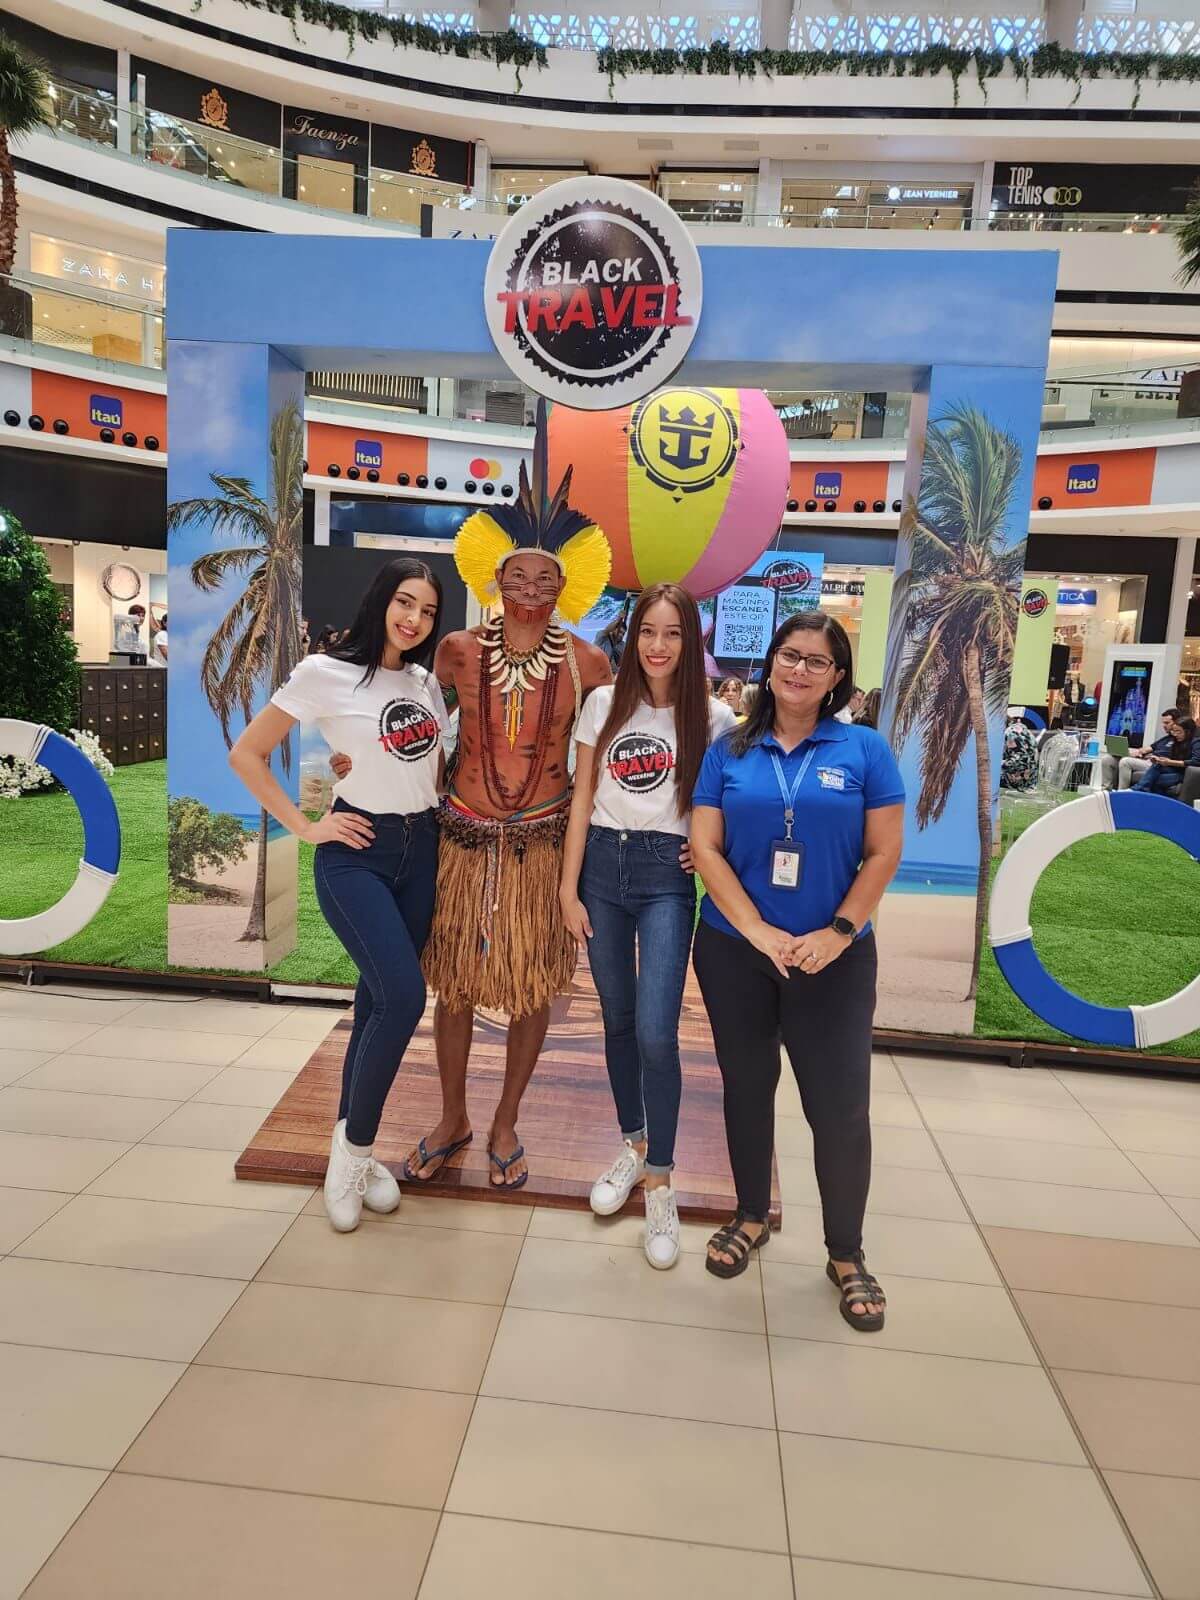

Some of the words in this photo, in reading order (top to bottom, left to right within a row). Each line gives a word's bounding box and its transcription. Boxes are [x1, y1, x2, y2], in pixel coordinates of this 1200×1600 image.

[291, 115, 360, 150] Faenza
[1010, 166, 1033, 186] TOP
[902, 190, 923, 199] JEAN
[924, 190, 959, 199] VERNIER
[1008, 185, 1042, 206] TENIS
[542, 257, 643, 286] BLACK
[497, 281, 693, 334] TRAVEL
[91, 408, 121, 426] Itaú
[356, 451, 381, 466] Itaú
[815, 484, 840, 496] Itaú
[1068, 477, 1097, 491] Itaú
[770, 567, 800, 578] BLACK
[722, 605, 769, 613] ESCANEA
[391, 713, 425, 731] BLACK
[378, 718, 441, 753] TRAVEL
[618, 745, 658, 761] BLACK
[607, 751, 676, 782] TRAVEL
